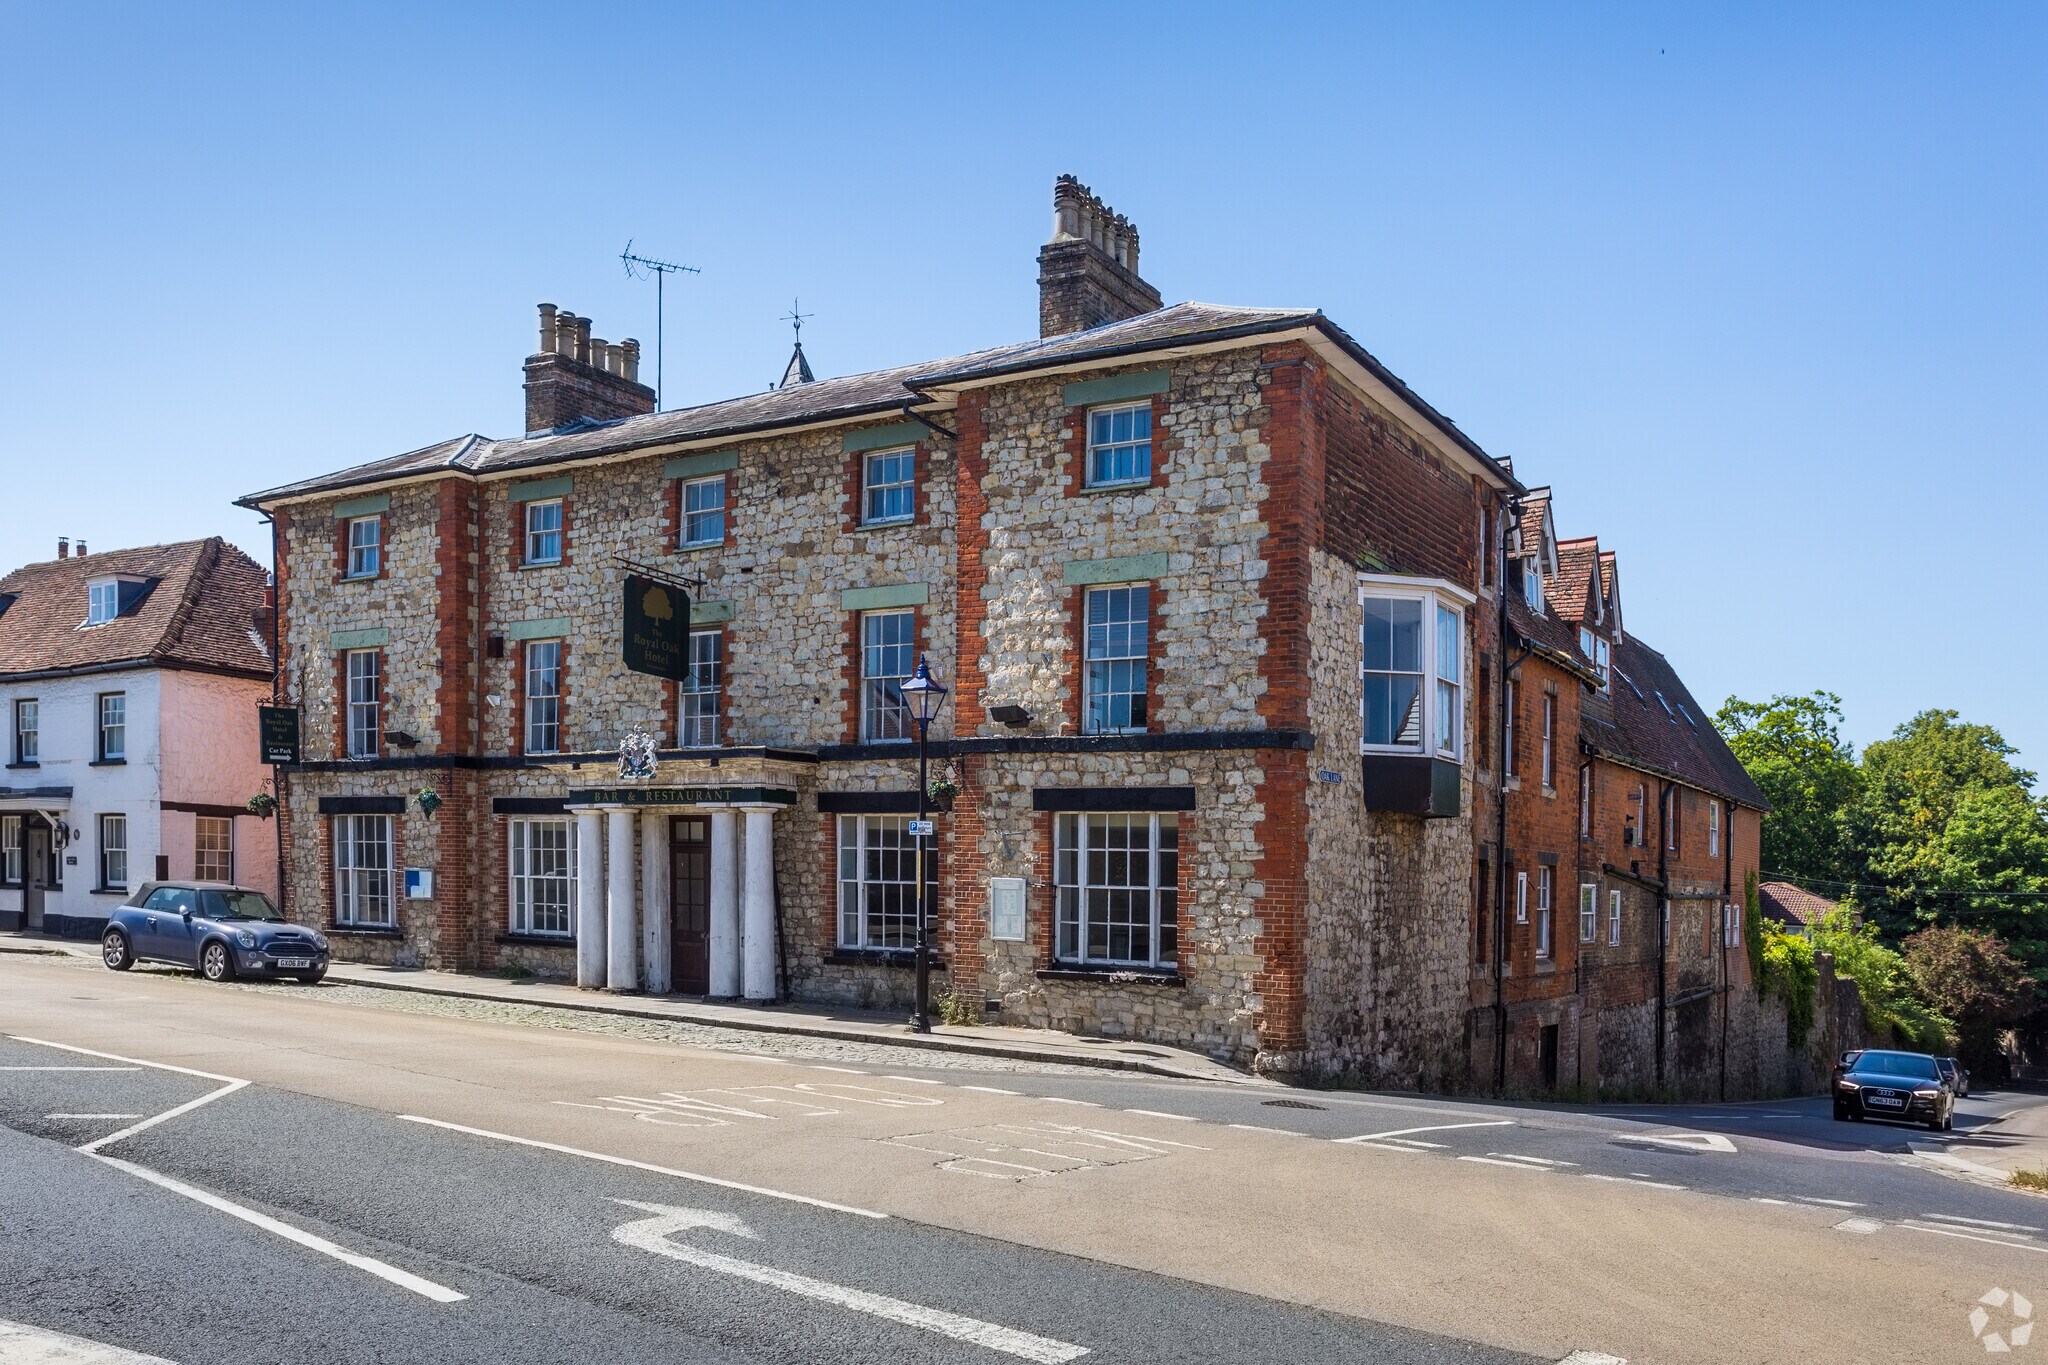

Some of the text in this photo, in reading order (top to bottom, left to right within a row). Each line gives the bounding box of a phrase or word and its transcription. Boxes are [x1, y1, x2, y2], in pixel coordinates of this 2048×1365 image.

[652, 628, 663, 638] The
[634, 633, 680, 654] Royal Oak
[644, 650, 669, 665] Hotel
[594, 790, 732, 802] BAR & RESTAURANT
[280, 959, 297, 967] GX06
